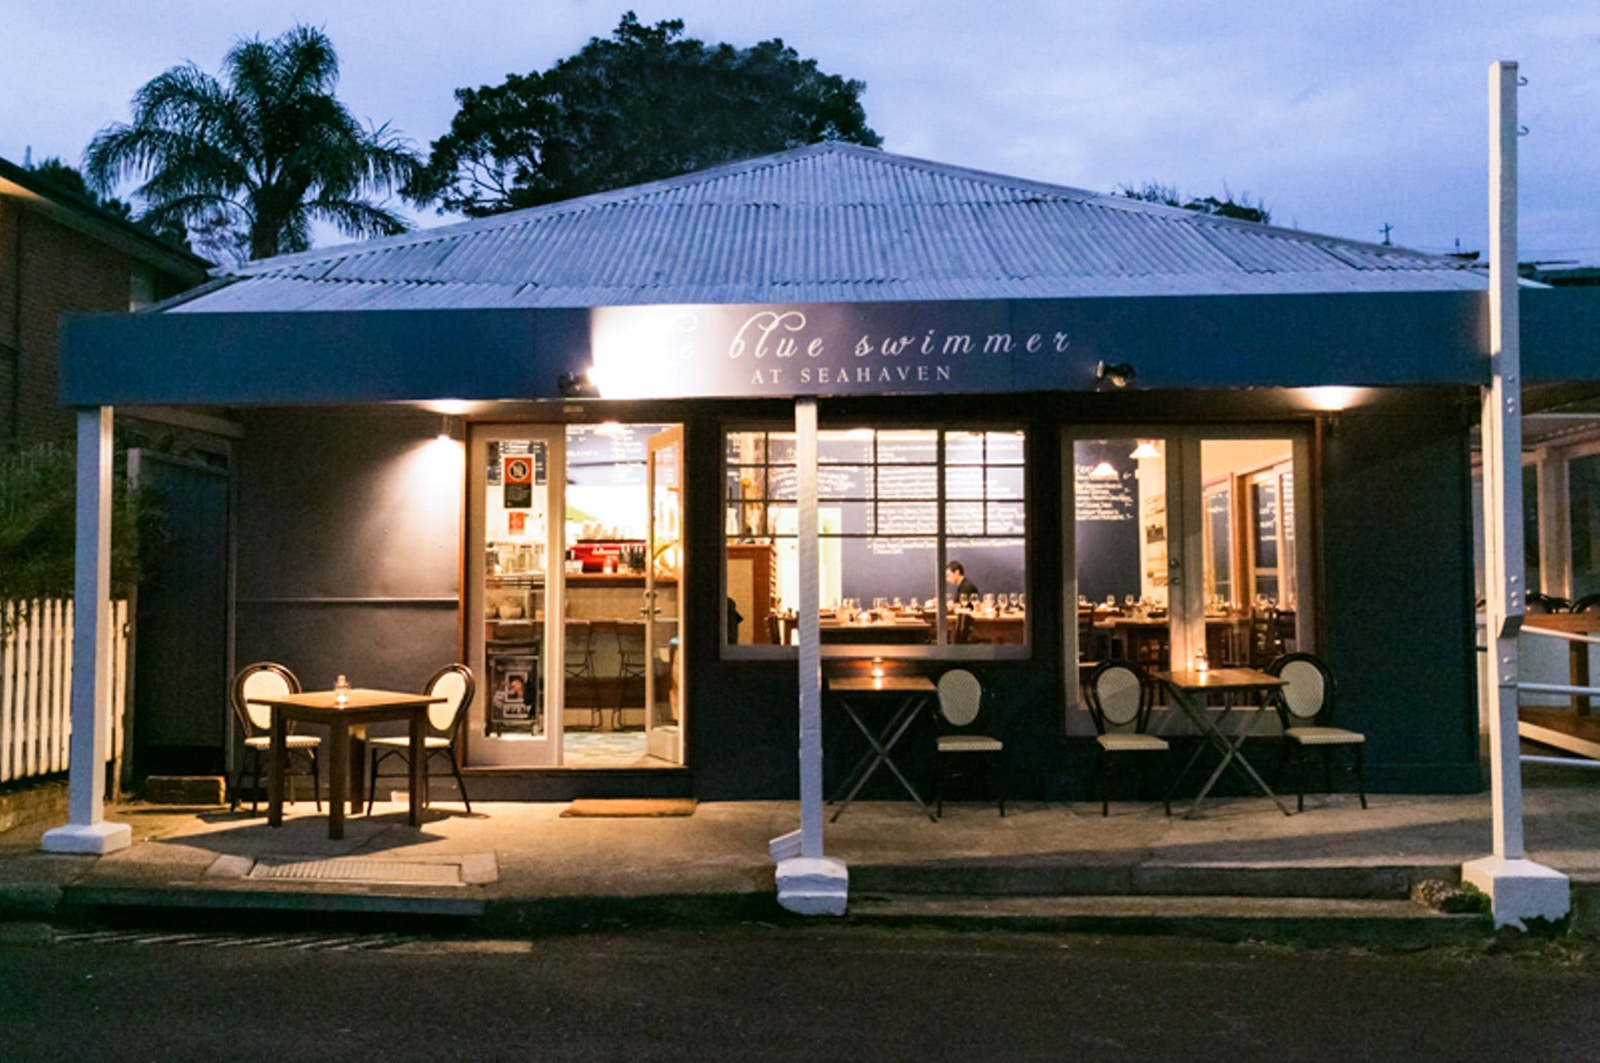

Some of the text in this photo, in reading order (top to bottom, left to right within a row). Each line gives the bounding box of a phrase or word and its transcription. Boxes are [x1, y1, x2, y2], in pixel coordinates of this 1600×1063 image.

[728, 311, 824, 359] blue
[854, 328, 1070, 357] swimmer
[751, 365, 950, 384] AT SEAHAVEN
